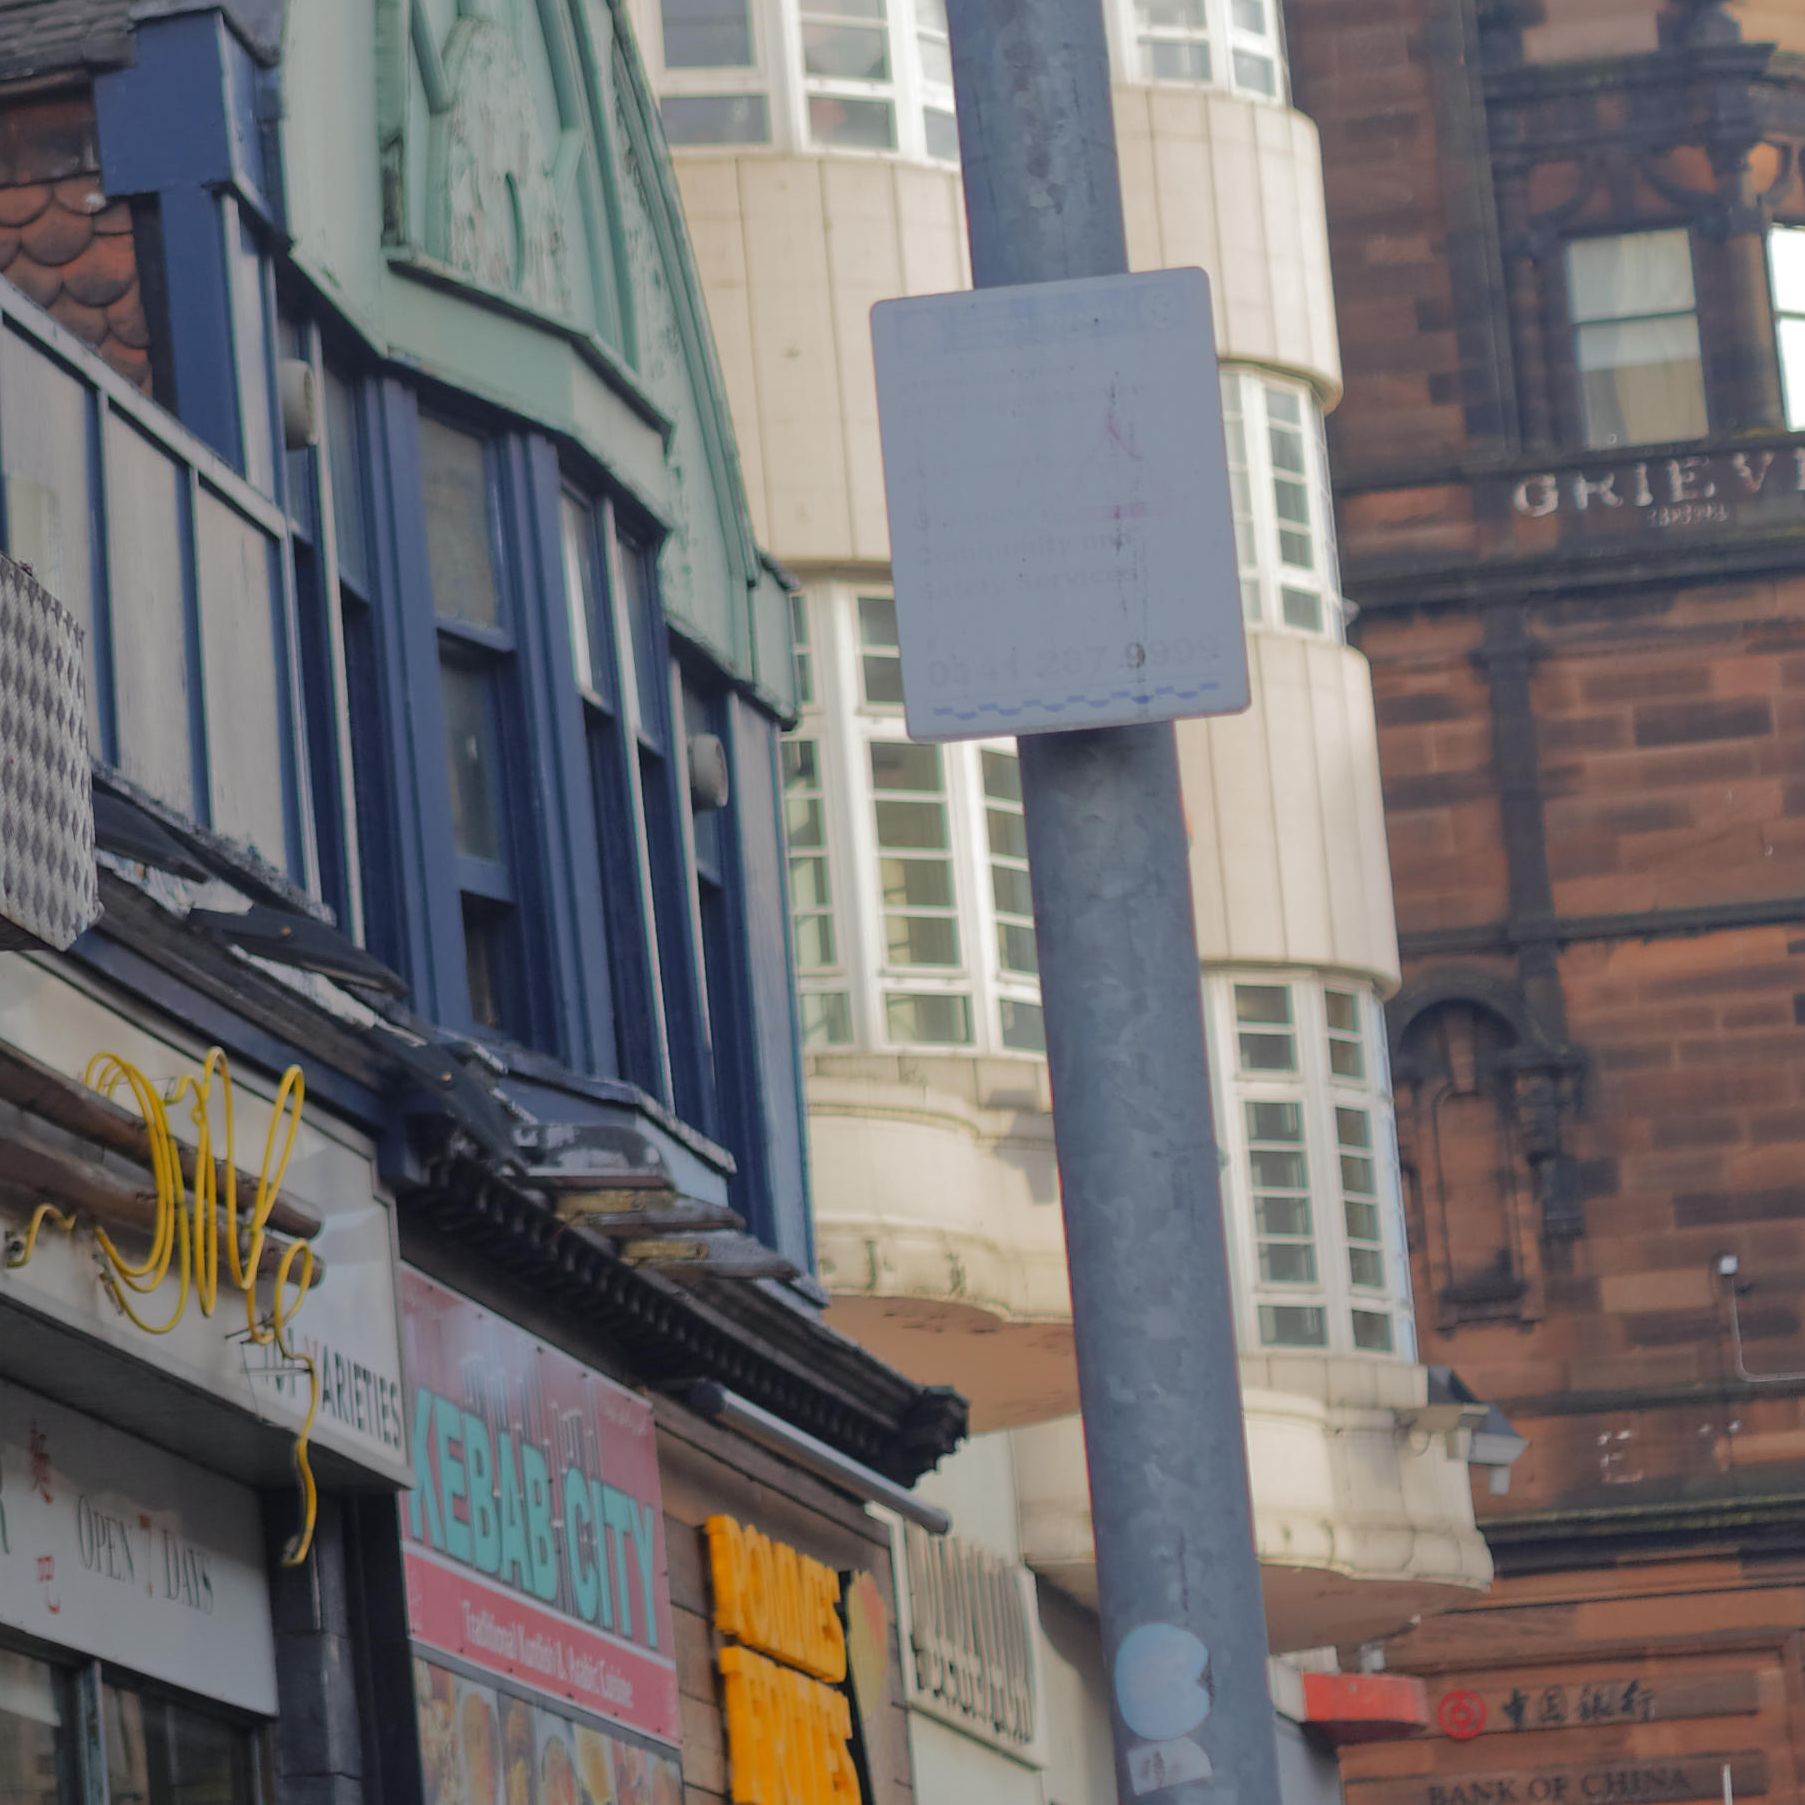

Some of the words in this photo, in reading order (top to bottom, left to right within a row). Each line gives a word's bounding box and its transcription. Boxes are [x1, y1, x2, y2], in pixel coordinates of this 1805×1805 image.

[407, 1386, 559, 1602] KEBAB
[561, 1465, 658, 1648] CITY
[1428, 1779, 1518, 1805] BANK
[1527, 1775, 1569, 1802] OF
[1581, 1767, 1689, 1797] CHINA
